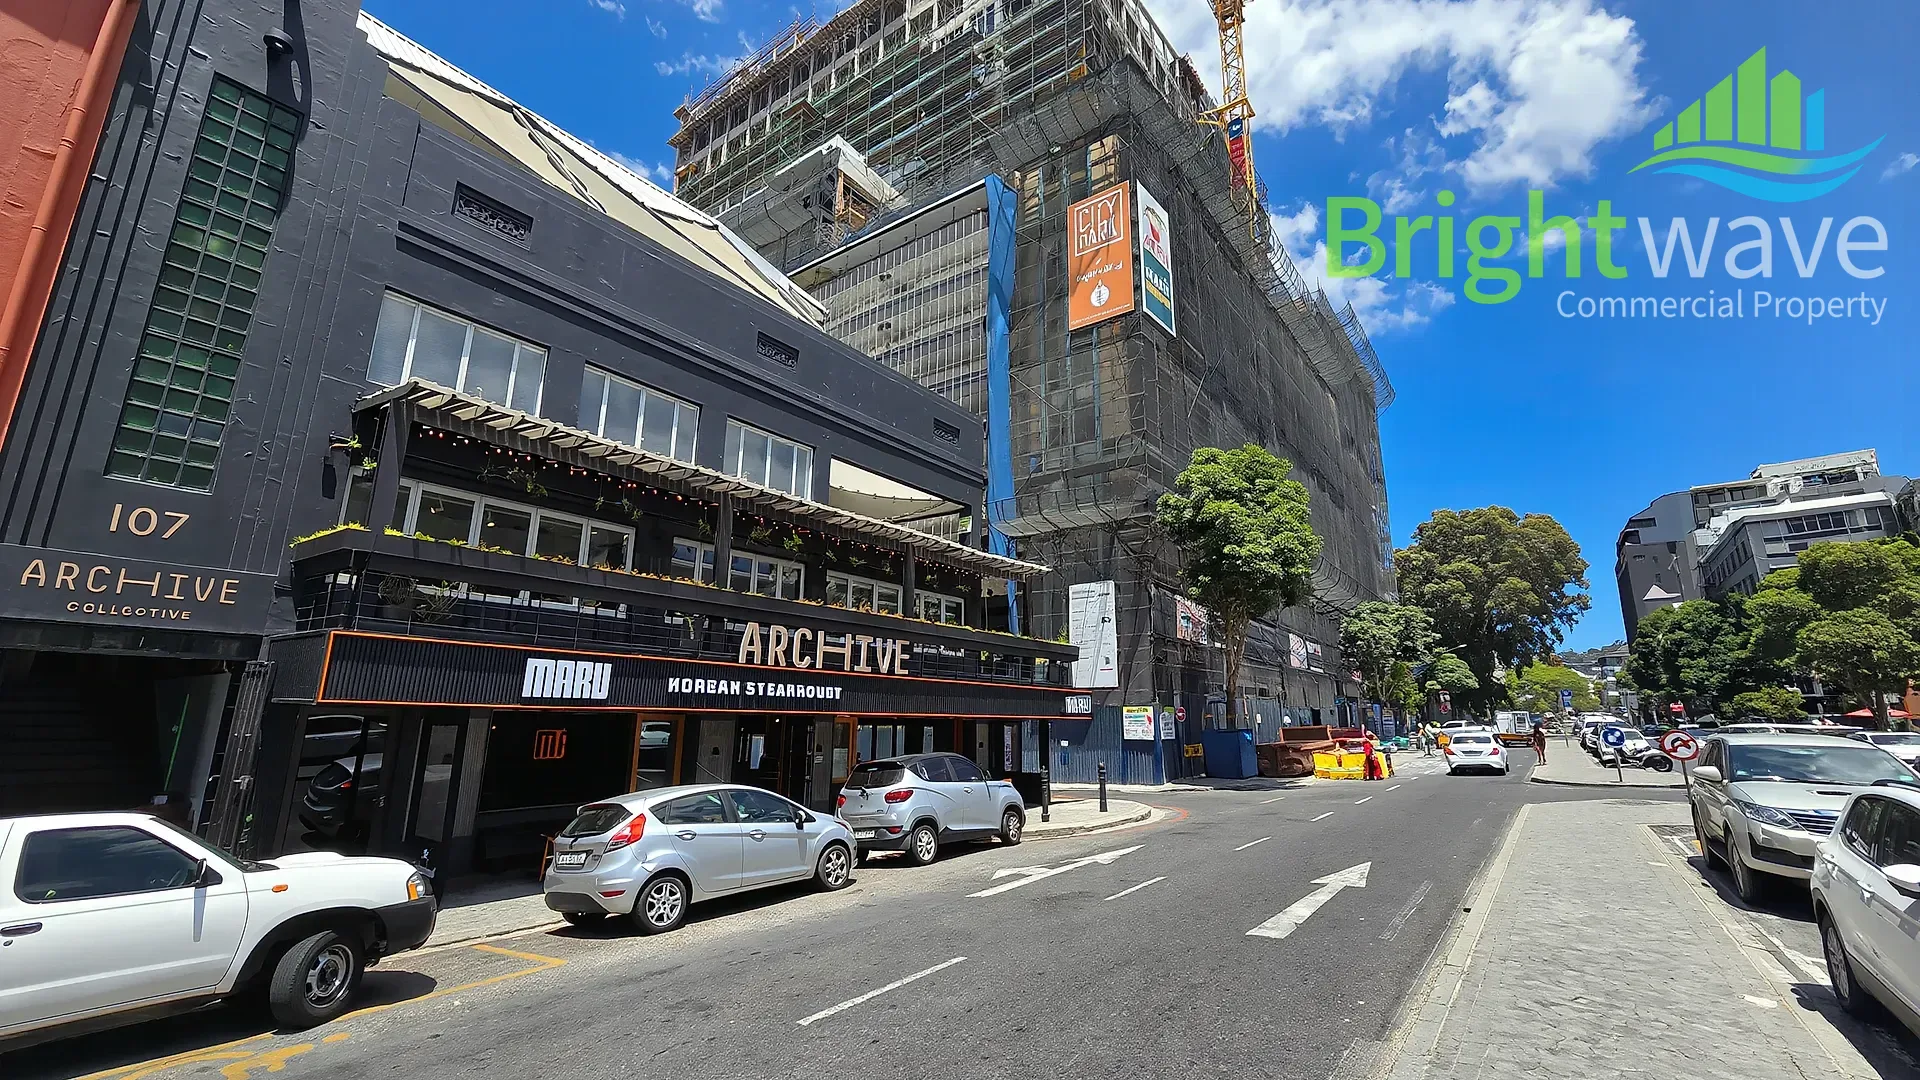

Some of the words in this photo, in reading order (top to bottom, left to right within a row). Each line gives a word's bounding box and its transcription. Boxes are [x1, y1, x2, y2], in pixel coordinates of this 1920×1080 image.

[109, 503, 191, 540] 107
[20, 558, 241, 605] ARCHIVE
[738, 621, 910, 676] ARCHIVE
[522, 658, 612, 700] MARU
